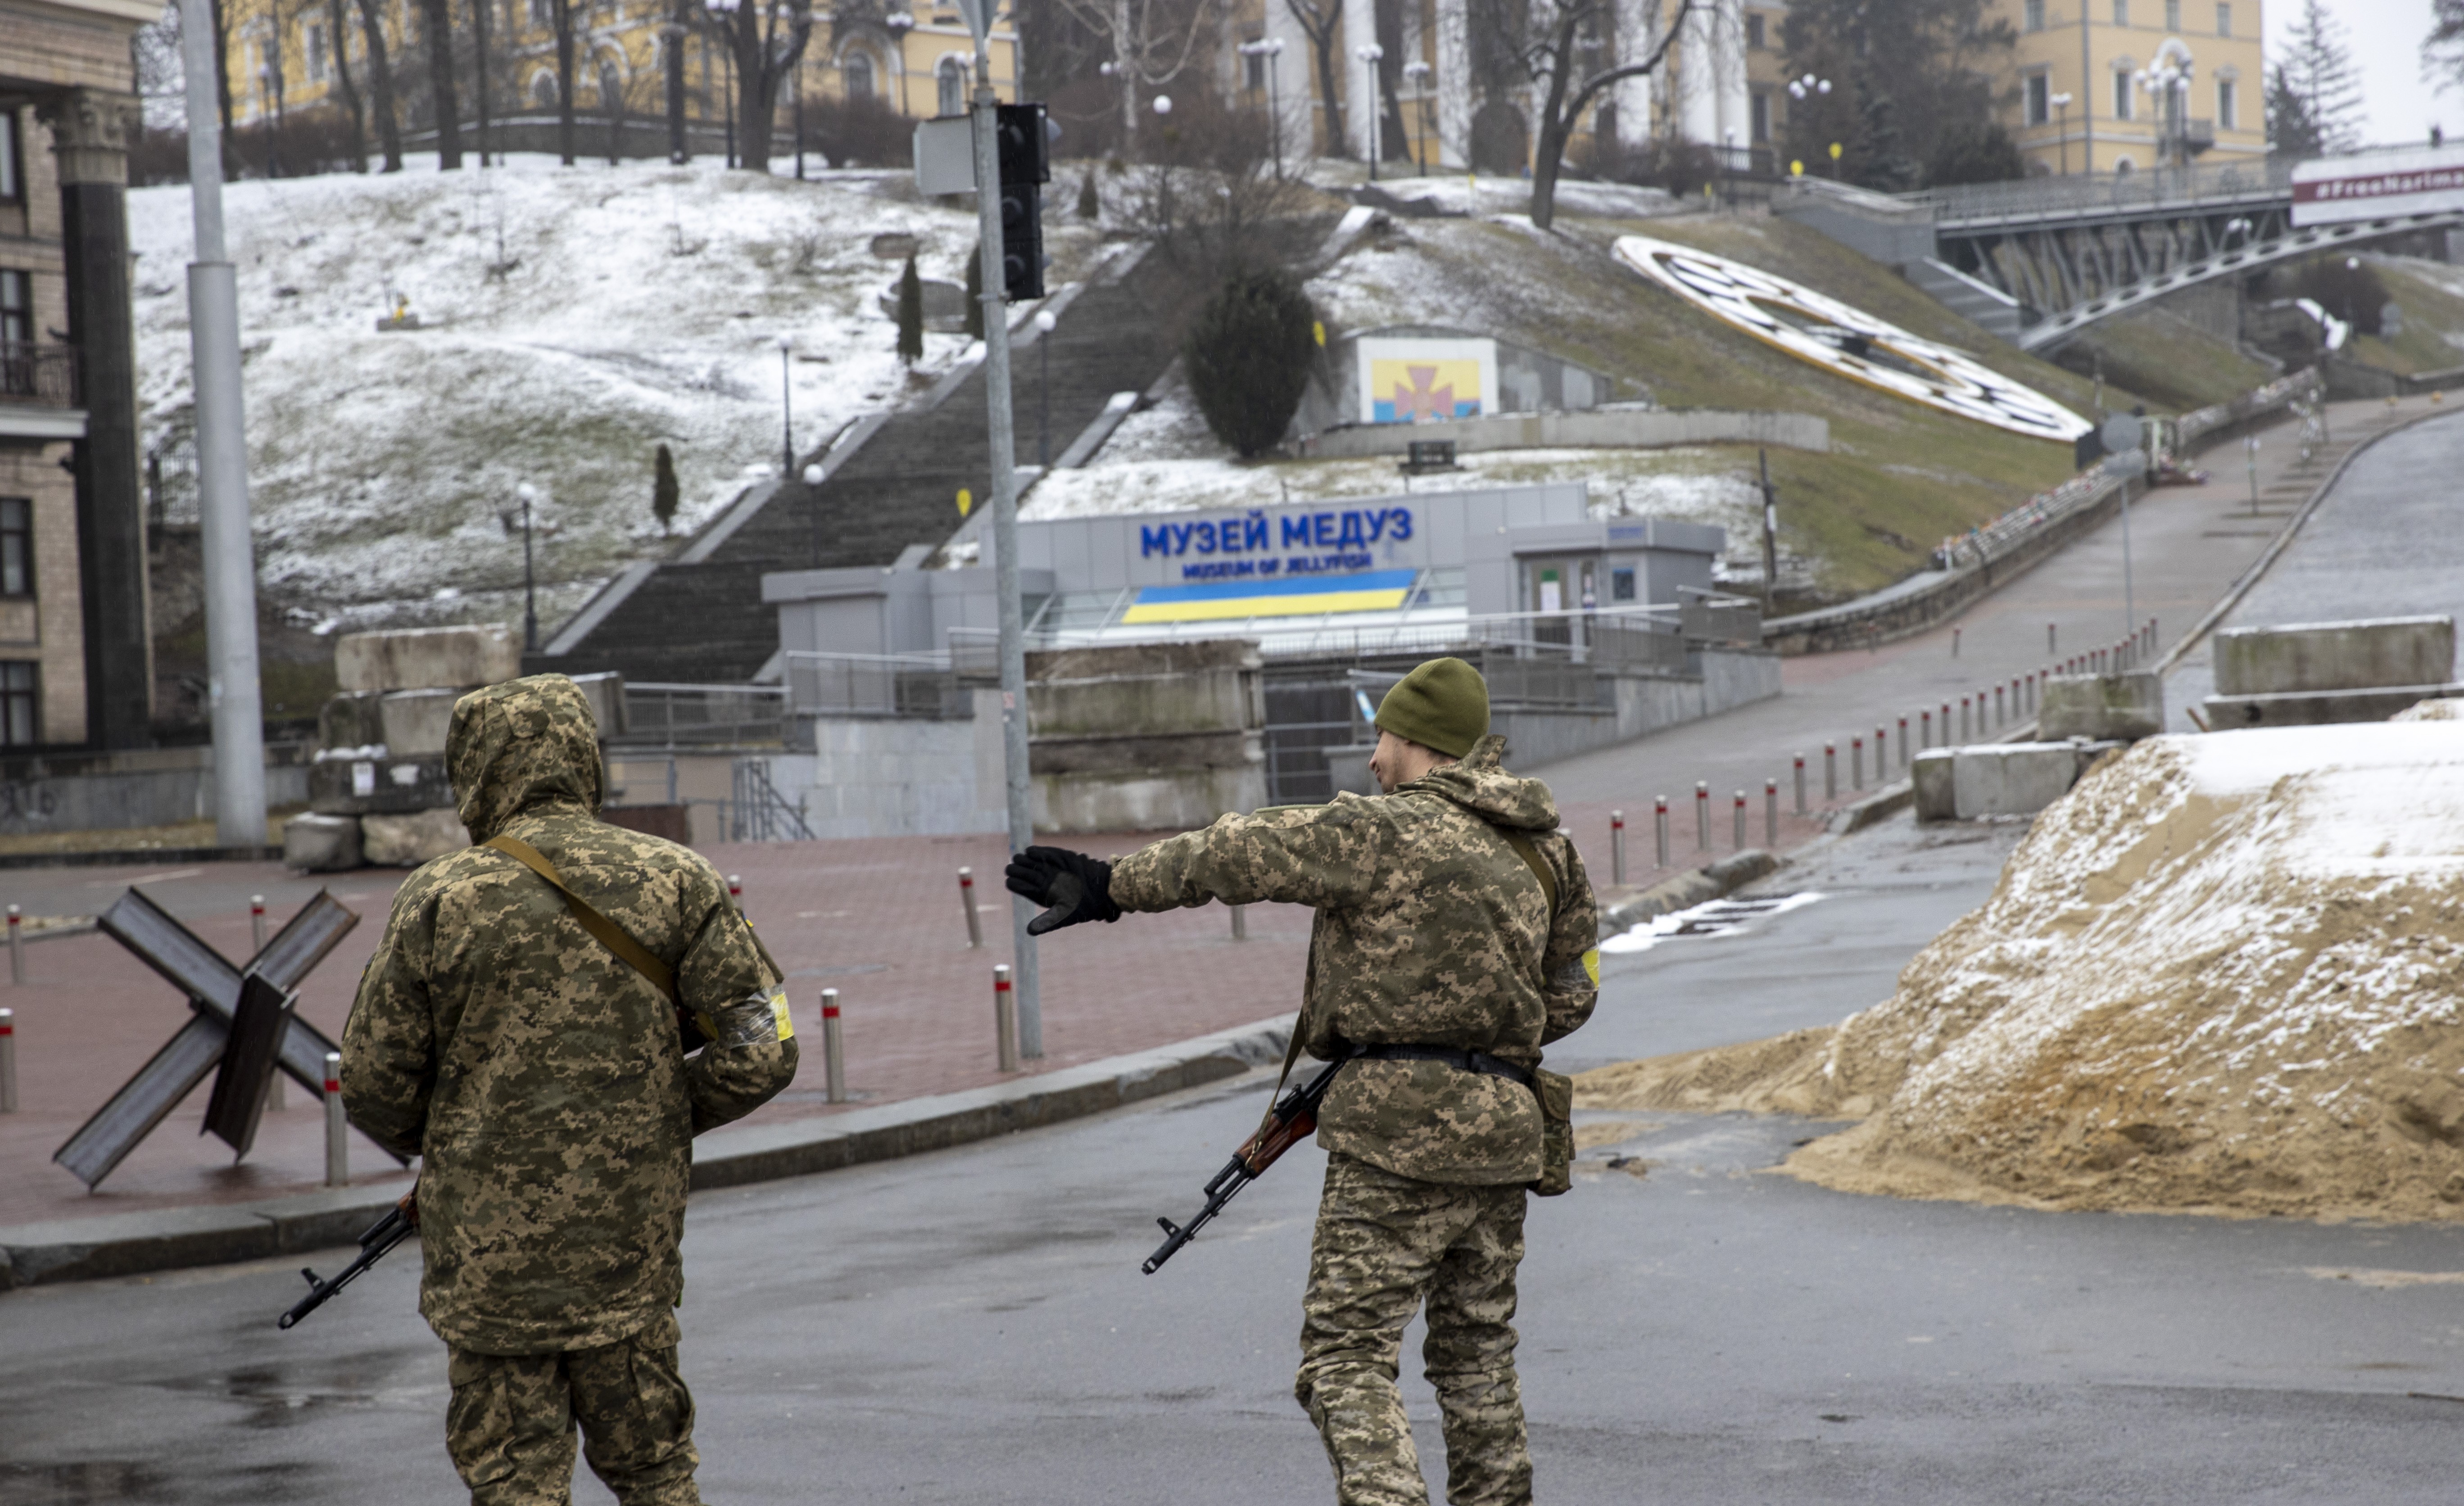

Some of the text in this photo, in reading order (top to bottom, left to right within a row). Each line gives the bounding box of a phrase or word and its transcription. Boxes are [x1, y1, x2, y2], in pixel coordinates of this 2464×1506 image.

[1141, 507, 1413, 557] МУЗЕЙ МЕДУЗ
[1182, 552, 1372, 579] MUSEUM OF JELLYFISH
